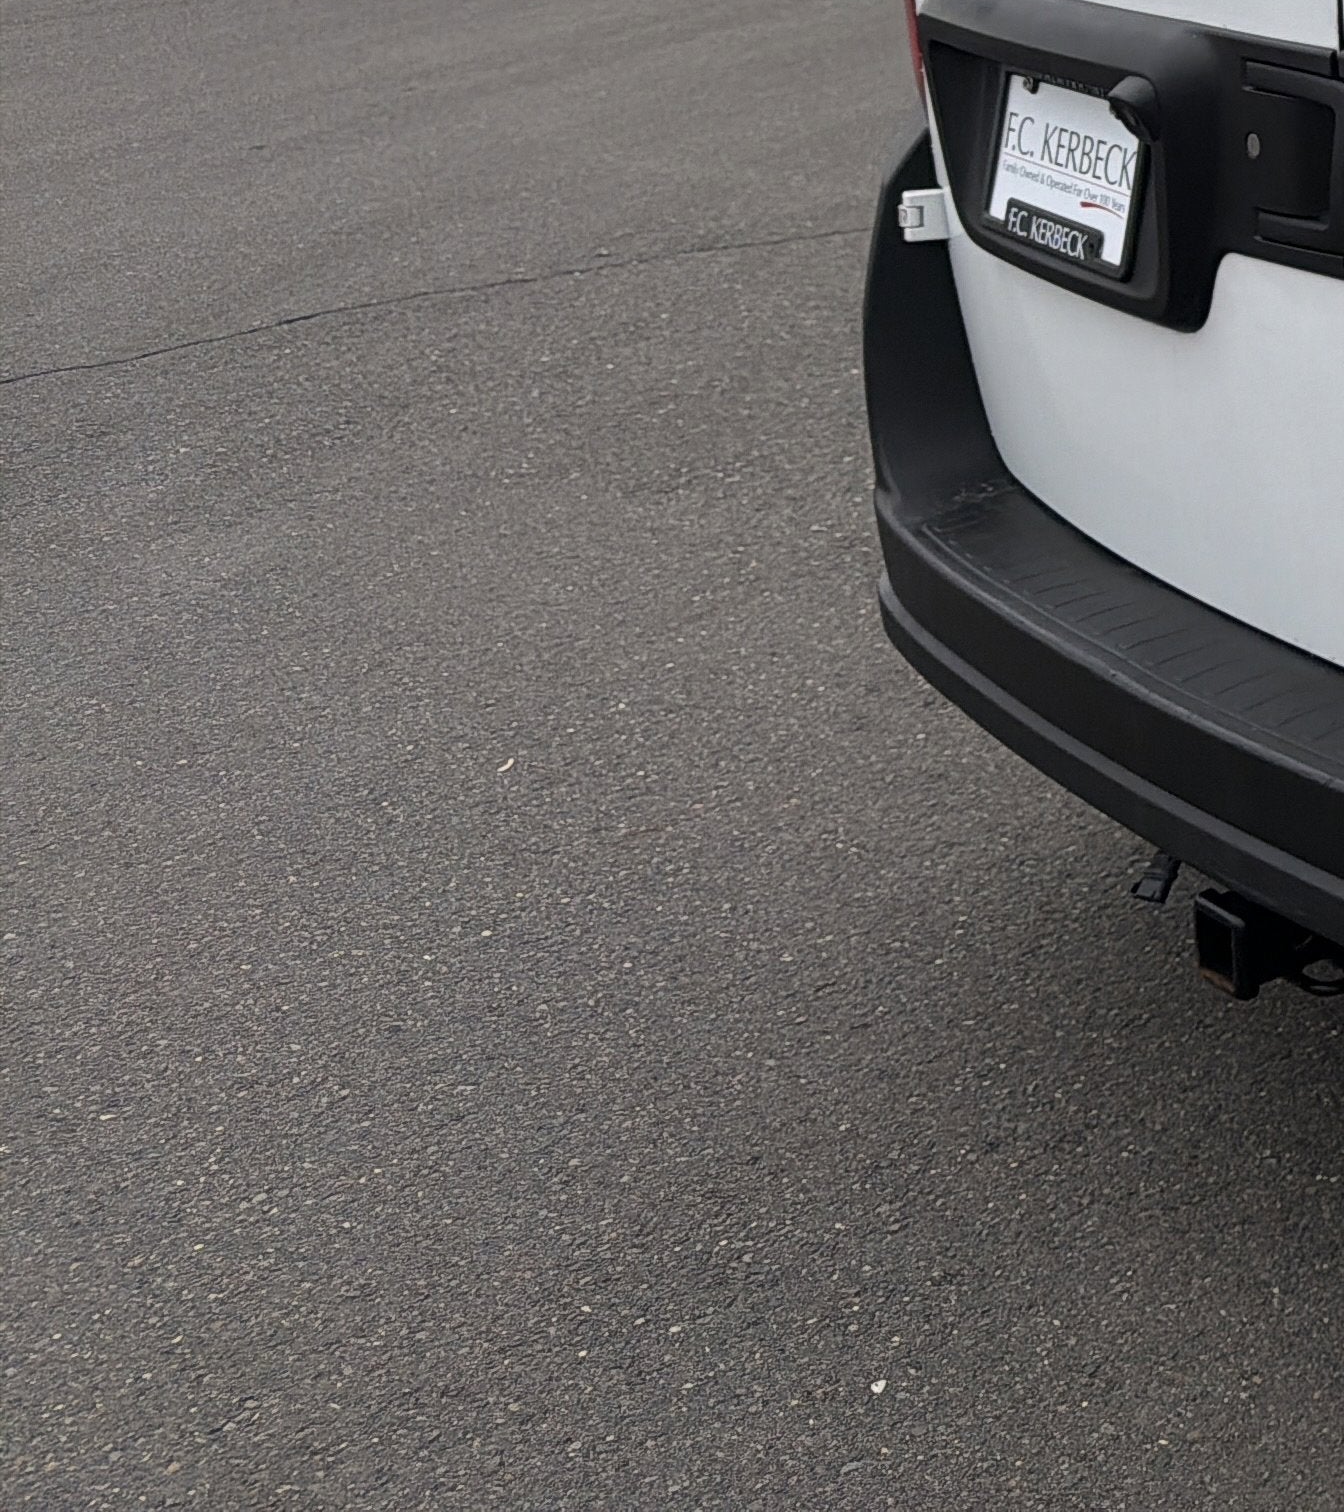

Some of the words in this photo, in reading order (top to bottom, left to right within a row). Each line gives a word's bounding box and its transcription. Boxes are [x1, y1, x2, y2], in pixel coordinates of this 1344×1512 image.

[1004, 112, 1035, 158] F.C.
[1041, 122, 1137, 191] KERBECK
[1019, 165, 1040, 183] Owned
[1046, 174, 1074, 194] Operated
[1084, 187, 1099, 201] Over
[1111, 196, 1126, 213] Years
[1029, 215, 1089, 261] KERBECK
